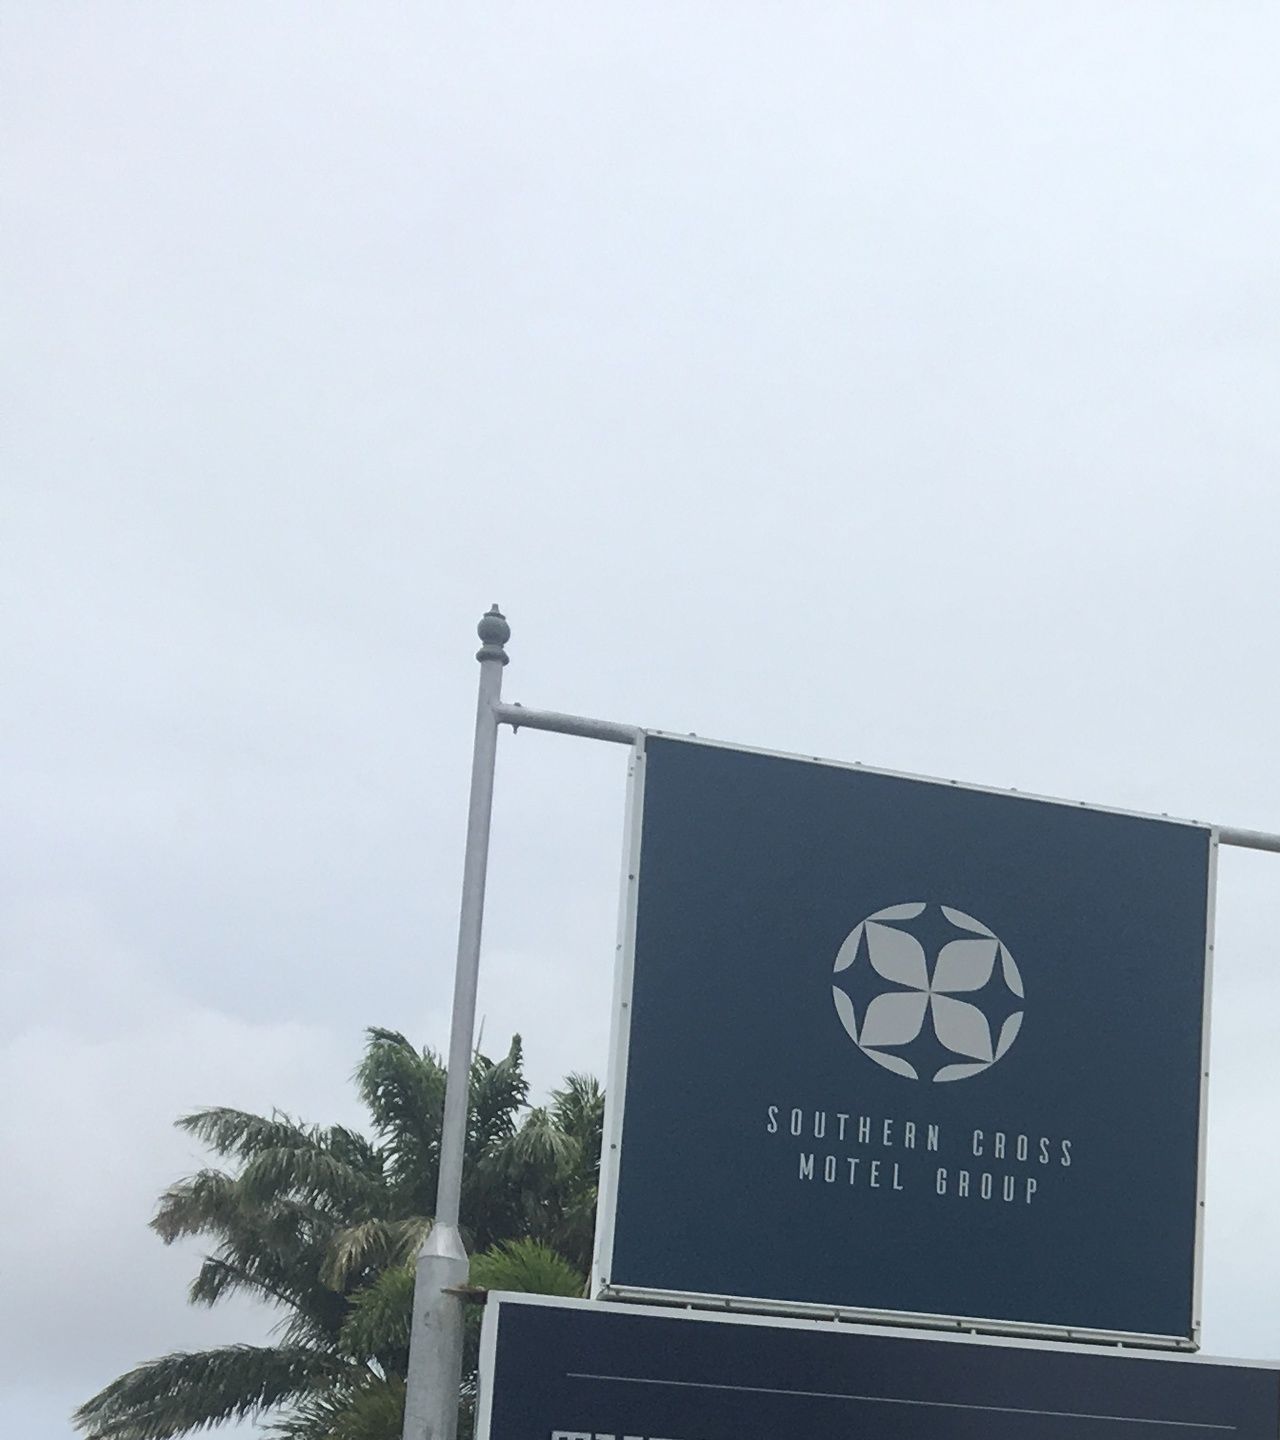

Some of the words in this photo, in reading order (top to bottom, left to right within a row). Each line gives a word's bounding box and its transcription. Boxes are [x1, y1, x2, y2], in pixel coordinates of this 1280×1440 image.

[768, 1105, 939, 1151] SOUTHERN
[973, 1129, 1072, 1166] CROSS
[799, 1152, 904, 1190] MOTEL
[936, 1168, 1037, 1204] GROUP
